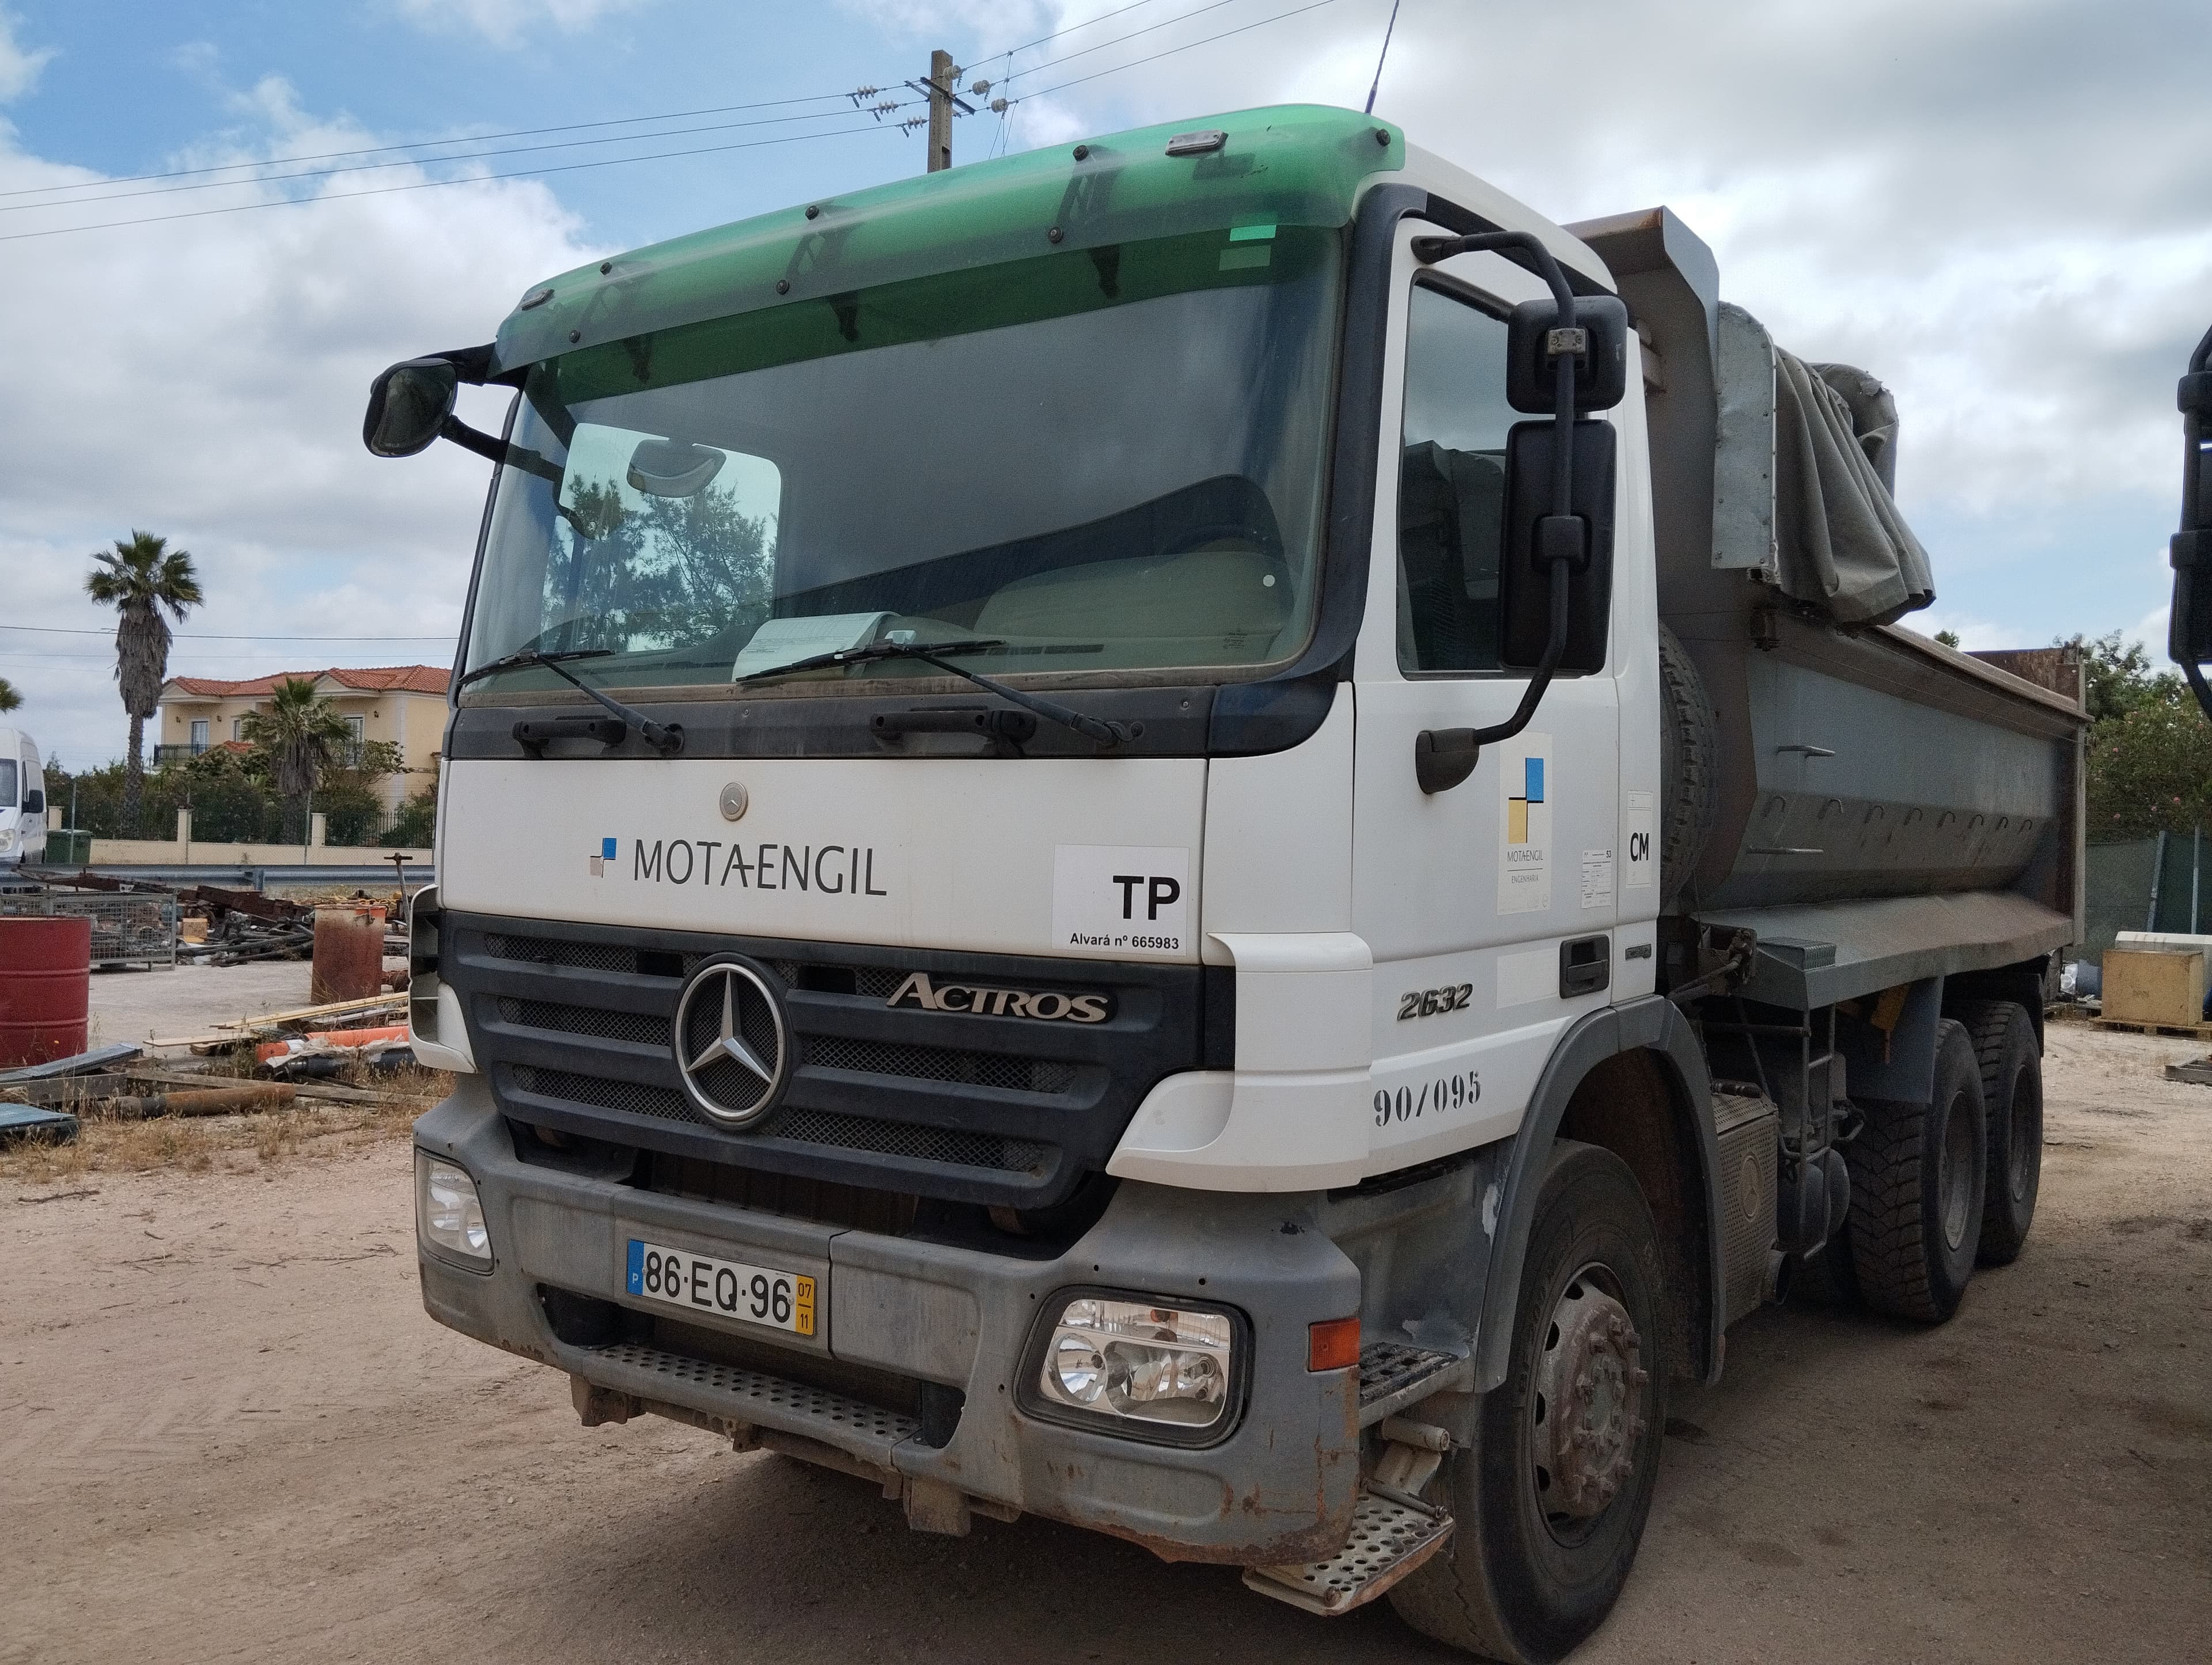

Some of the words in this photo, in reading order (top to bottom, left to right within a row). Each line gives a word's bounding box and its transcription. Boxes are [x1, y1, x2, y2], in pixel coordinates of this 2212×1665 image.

[1630, 832, 1650, 862] CM
[1112, 875, 1181, 921] TP
[1070, 932, 1111, 946] Alvará
[1131, 935, 1180, 950] 665983
[1397, 983, 1473, 1021] 2632
[1373, 1069, 1481, 1128] 90/095
[632, 1273, 639, 1284] P
[798, 1282, 812, 1299] 07
[800, 1313, 809, 1330] 11
